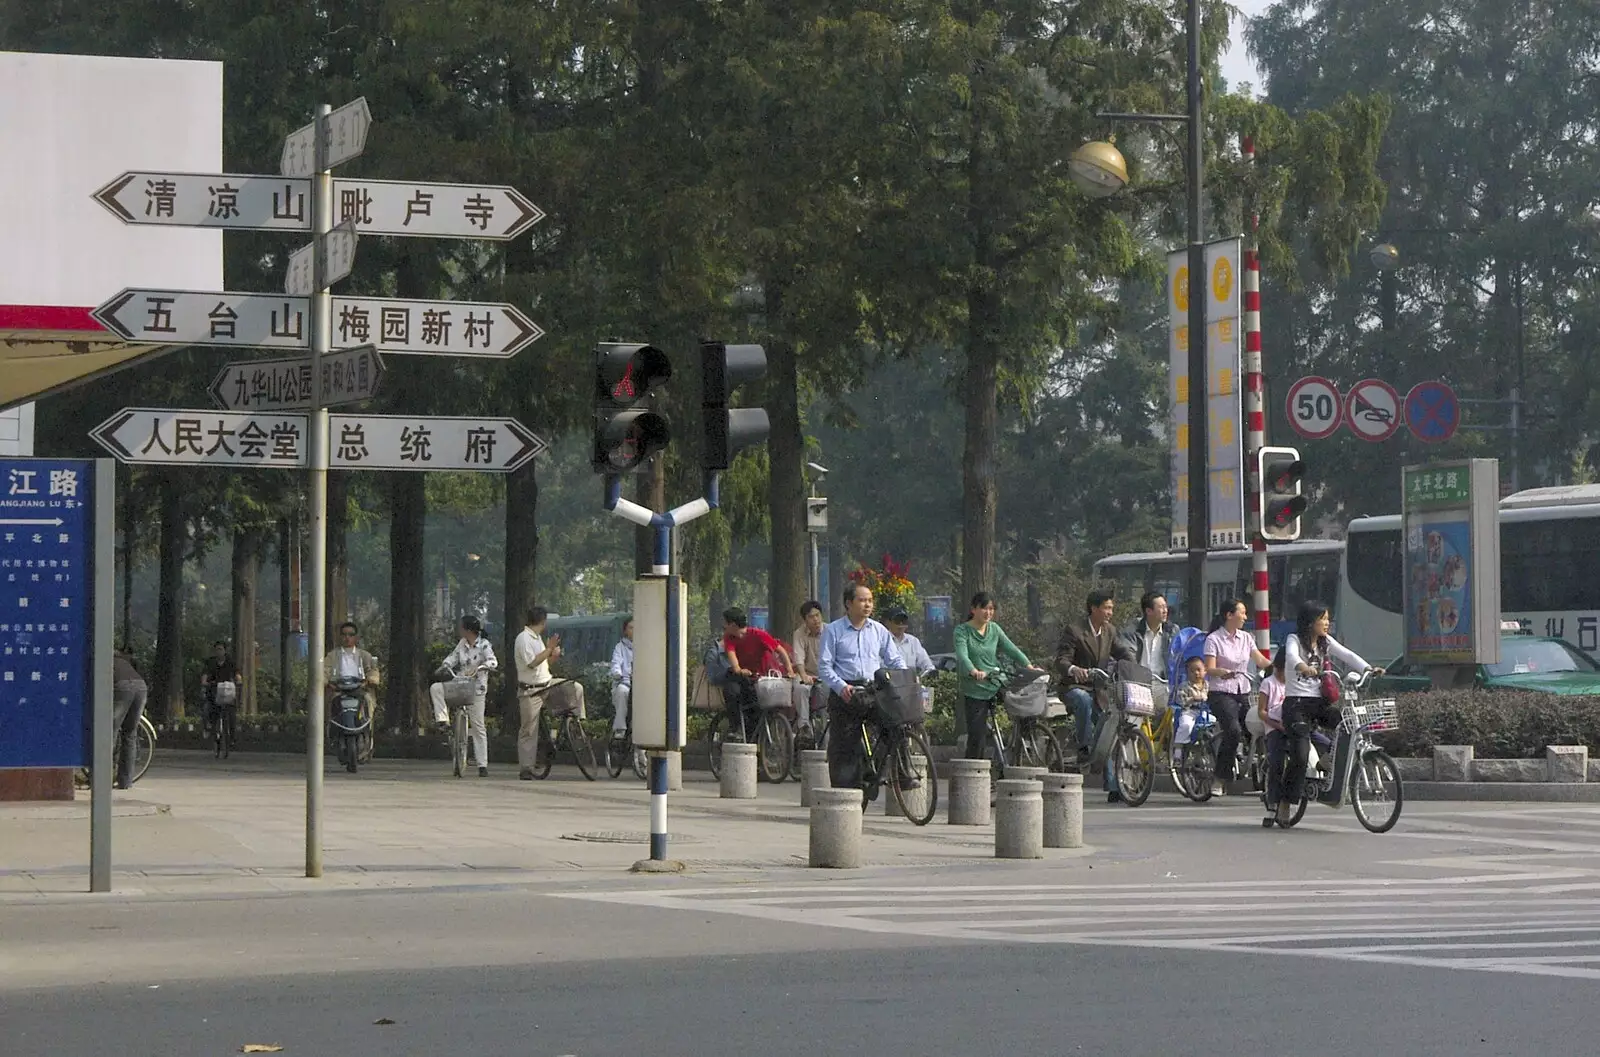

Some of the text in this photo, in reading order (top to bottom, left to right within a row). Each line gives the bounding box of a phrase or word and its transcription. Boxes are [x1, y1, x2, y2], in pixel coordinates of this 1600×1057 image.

[144, 179, 304, 222] 清凉山
[340, 188, 494, 231] 毗卢寺
[143, 297, 303, 340] 五台山
[339, 305, 495, 348] 梅园新村
[234, 365, 313, 406] 九华山公园
[1297, 394, 1333, 421] 50
[141, 418, 300, 461] 人民大会堂
[337, 424, 497, 463] 总统府
[1413, 471, 1458, 492] 太平北路
